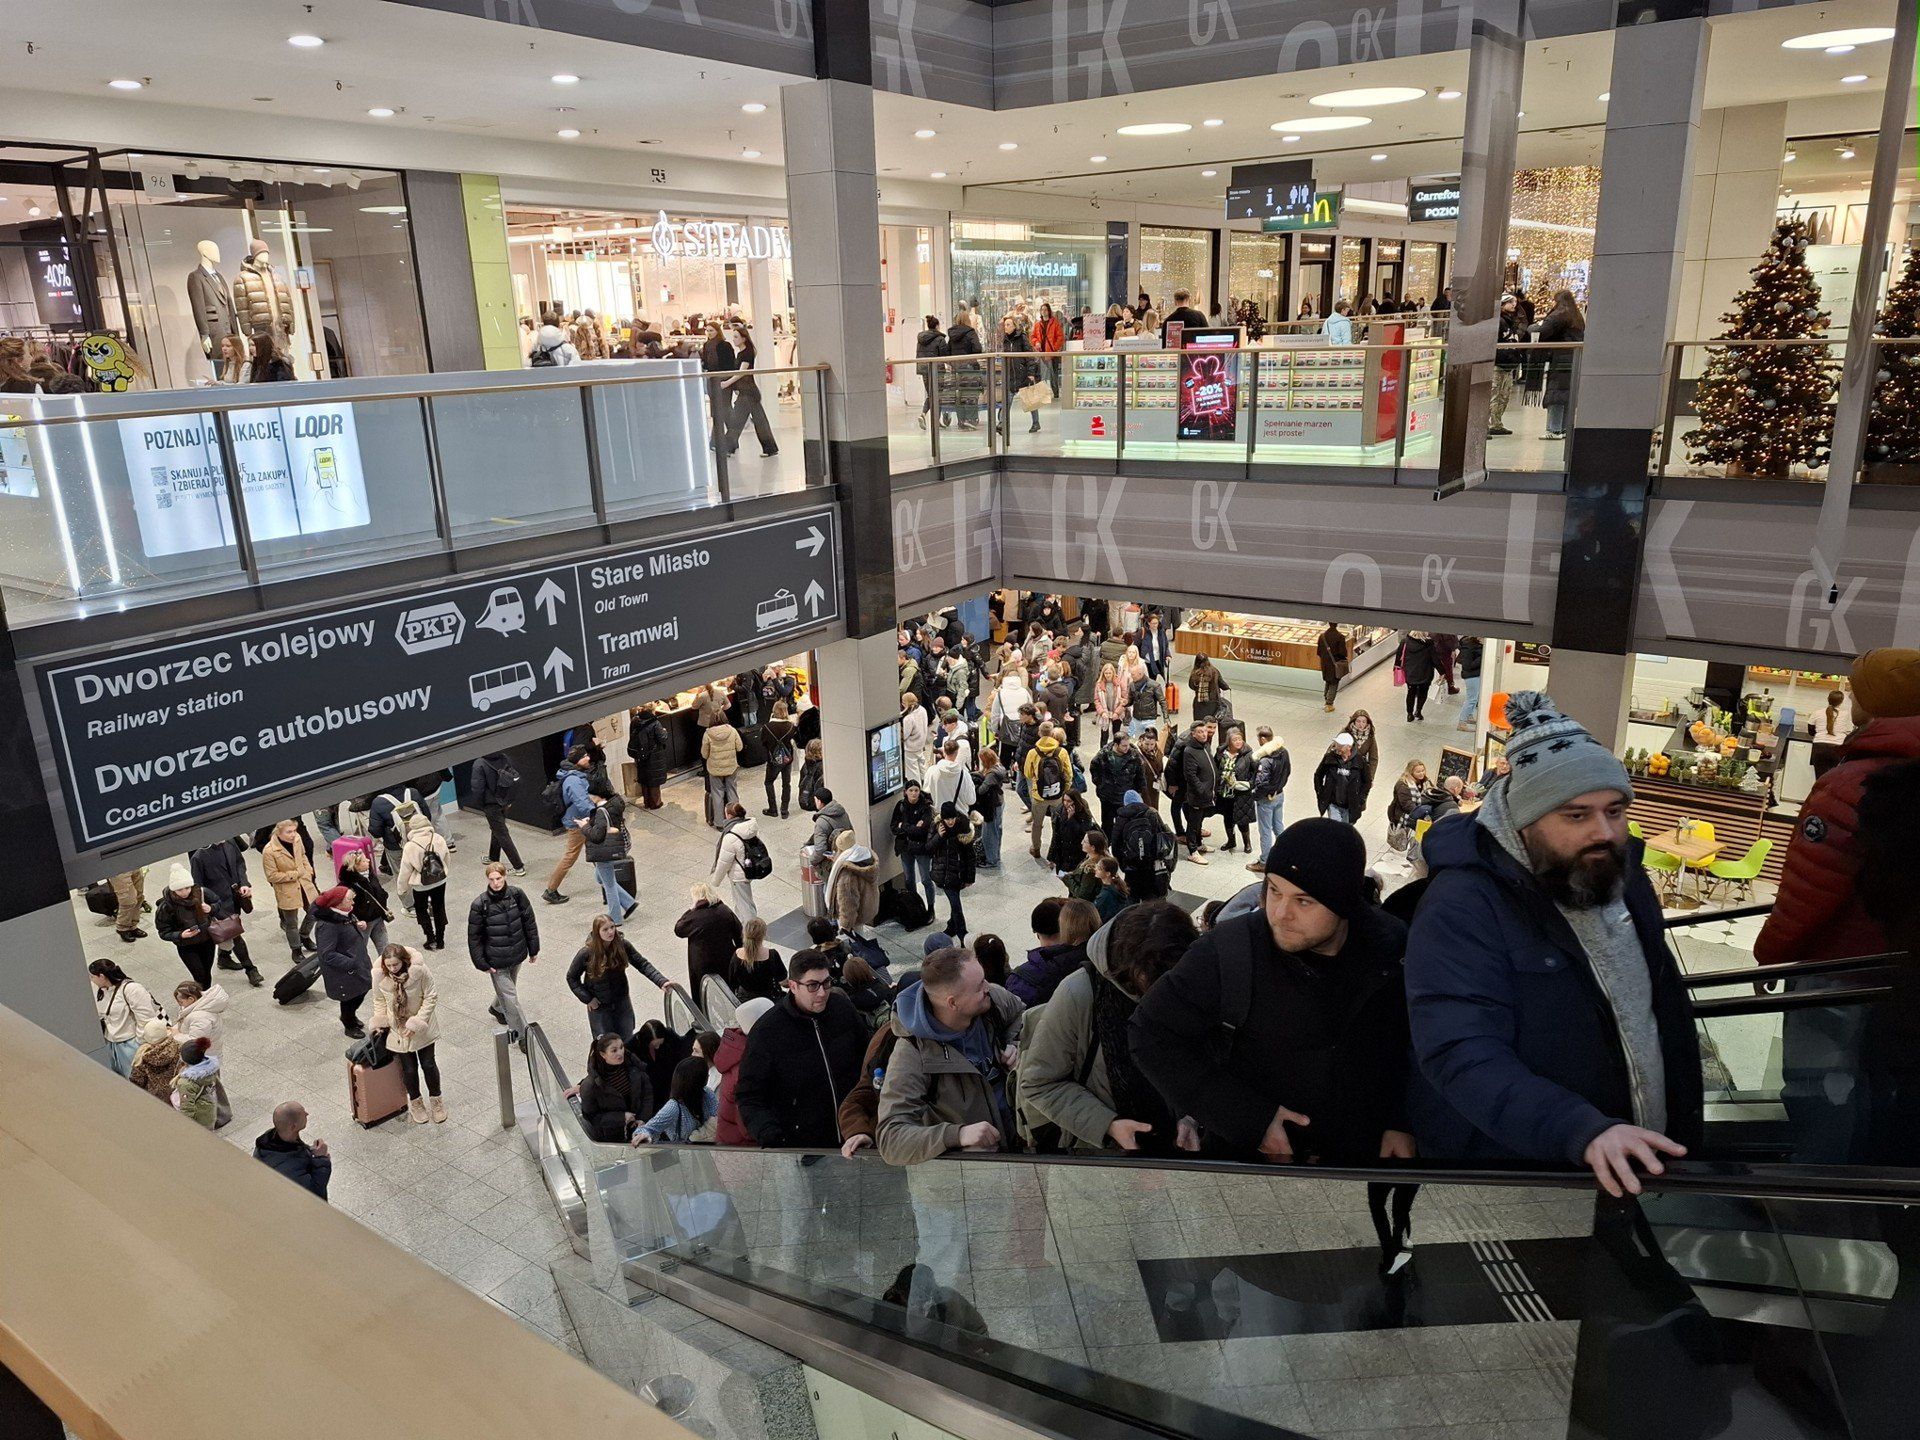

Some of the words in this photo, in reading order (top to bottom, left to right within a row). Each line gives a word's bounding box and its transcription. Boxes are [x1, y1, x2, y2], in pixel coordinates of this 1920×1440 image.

[1351, 7, 1386, 63] GK
[151, 176, 165, 187] 96
[1425, 206, 1460, 217] POZIO
[44, 263, 71, 287] -40%
[1195, 383, 1223, 396] -20%
[144, 427, 202, 450] POZNAJ
[208, 421, 282, 444] AIKACJĘ
[295, 413, 344, 439] LQDR
[170, 467, 201, 480] SKANUJ
[178, 478, 210, 491] ZBIERAJ
[247, 473, 257, 482] ZA
[1191, 480, 1238, 551] GK
[894, 498, 927, 572] GK
[590, 564, 644, 589] Stare
[649, 549, 710, 576] Miasto
[1421, 553, 1457, 604] GK
[594, 598, 616, 614] Old
[619, 592, 649, 607] Town
[405, 614, 457, 643] PKP
[598, 616, 679, 654] Tramwaj
[74, 651, 232, 704] Dworzec
[241, 619, 376, 667] kolejowy
[1240, 647, 1281, 658] KARMELLO
[601, 662, 631, 680] Tram
[87, 706, 171, 739] Railway
[176, 689, 244, 716] station
[94, 735, 248, 794] Dworzec
[258, 685, 432, 749] autobusowy
[105, 793, 175, 826] Coach
[181, 774, 248, 804] station
